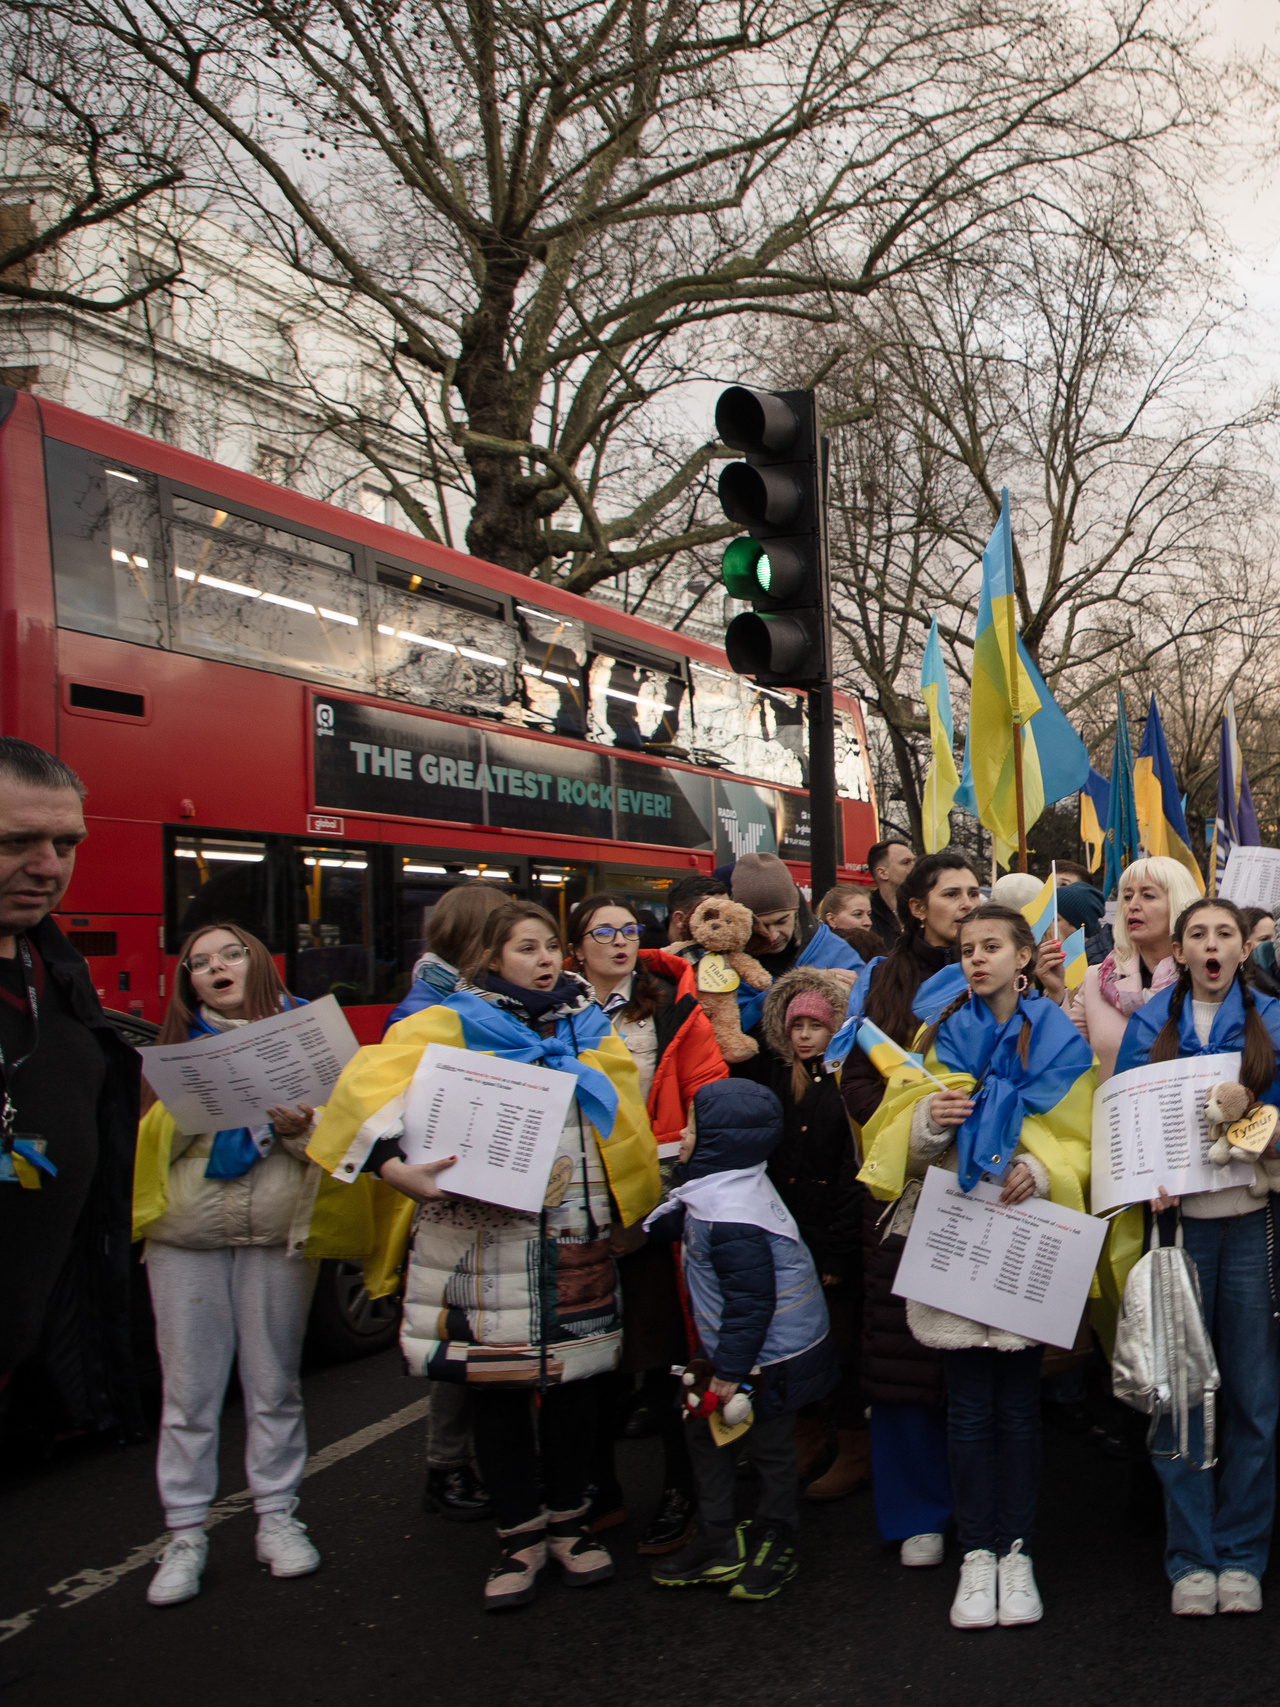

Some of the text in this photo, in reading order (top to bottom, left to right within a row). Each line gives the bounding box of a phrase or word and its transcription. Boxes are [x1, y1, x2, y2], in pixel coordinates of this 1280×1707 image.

[350, 741, 672, 819] THE GREATEST ROCK EVER!
[314, 818, 337, 830] global
[718, 808, 737, 819] RADIO
[28, 986, 38, 1018] SECURITY
[1232, 1114, 1272, 1138] Tymur
